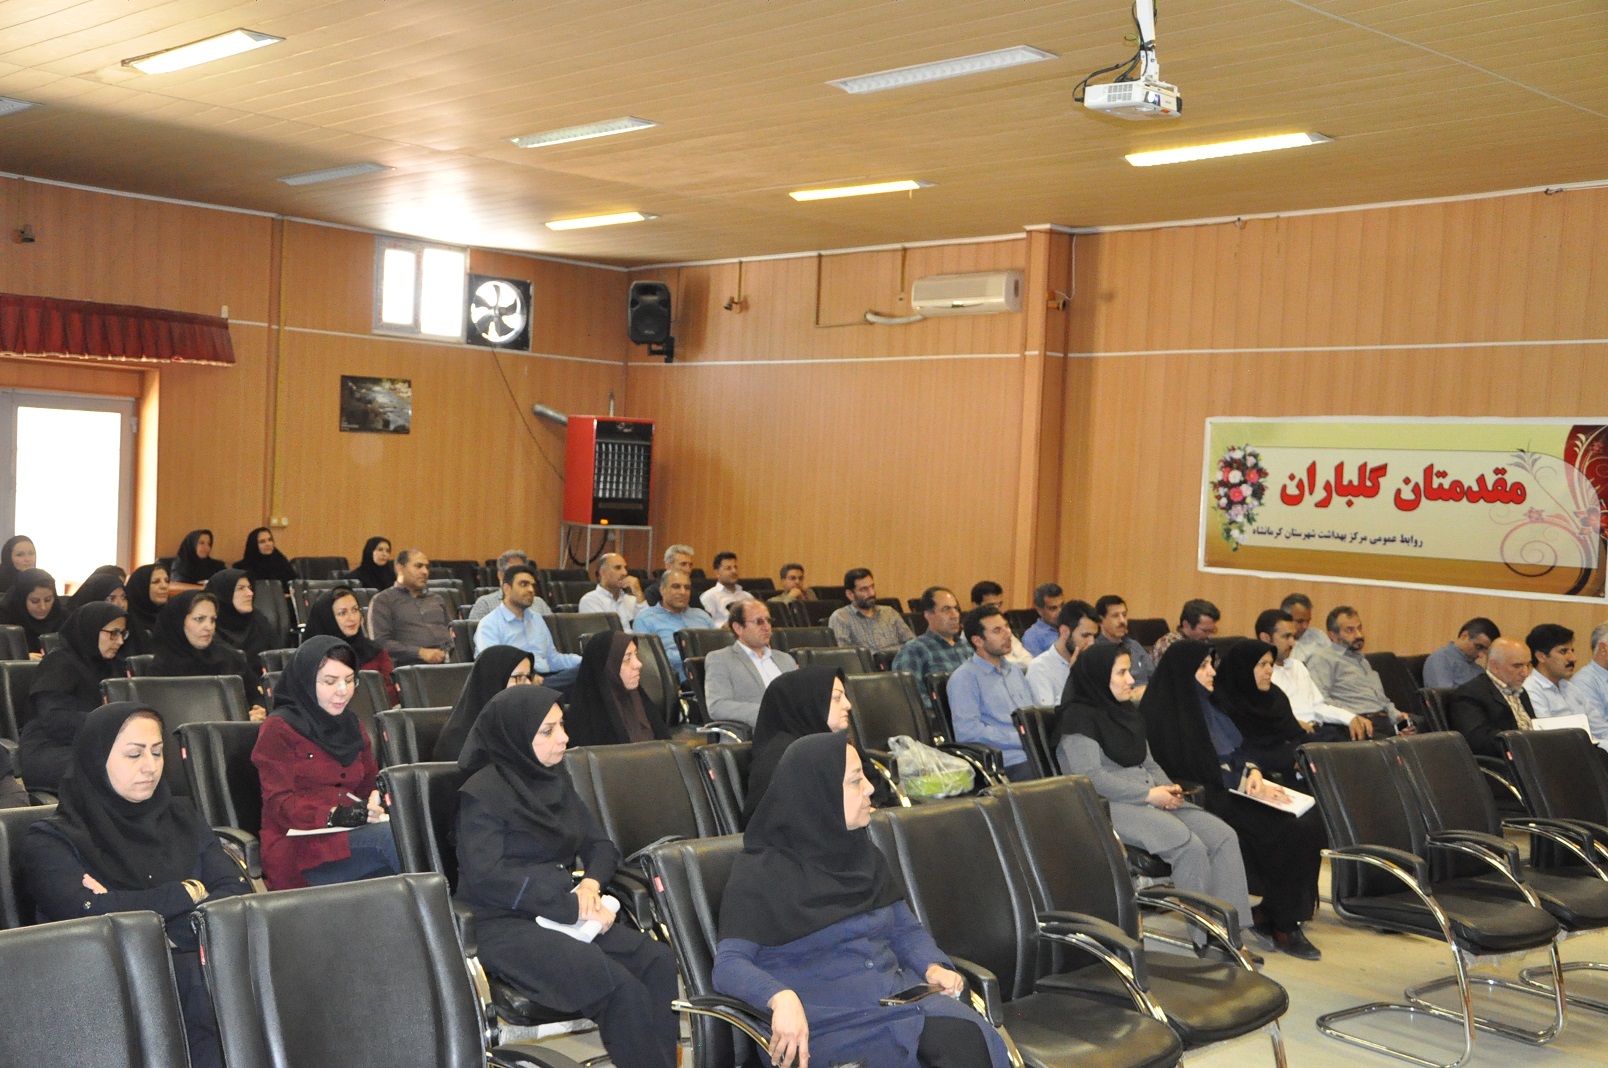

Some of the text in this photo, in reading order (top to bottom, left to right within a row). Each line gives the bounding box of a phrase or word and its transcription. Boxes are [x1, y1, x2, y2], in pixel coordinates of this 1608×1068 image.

[1280, 460, 1527, 512] مقدمتان گلباران
[1252, 526, 1423, 548] روابط عمومی مرکز بهداشت شهرستان کرمانشاه
